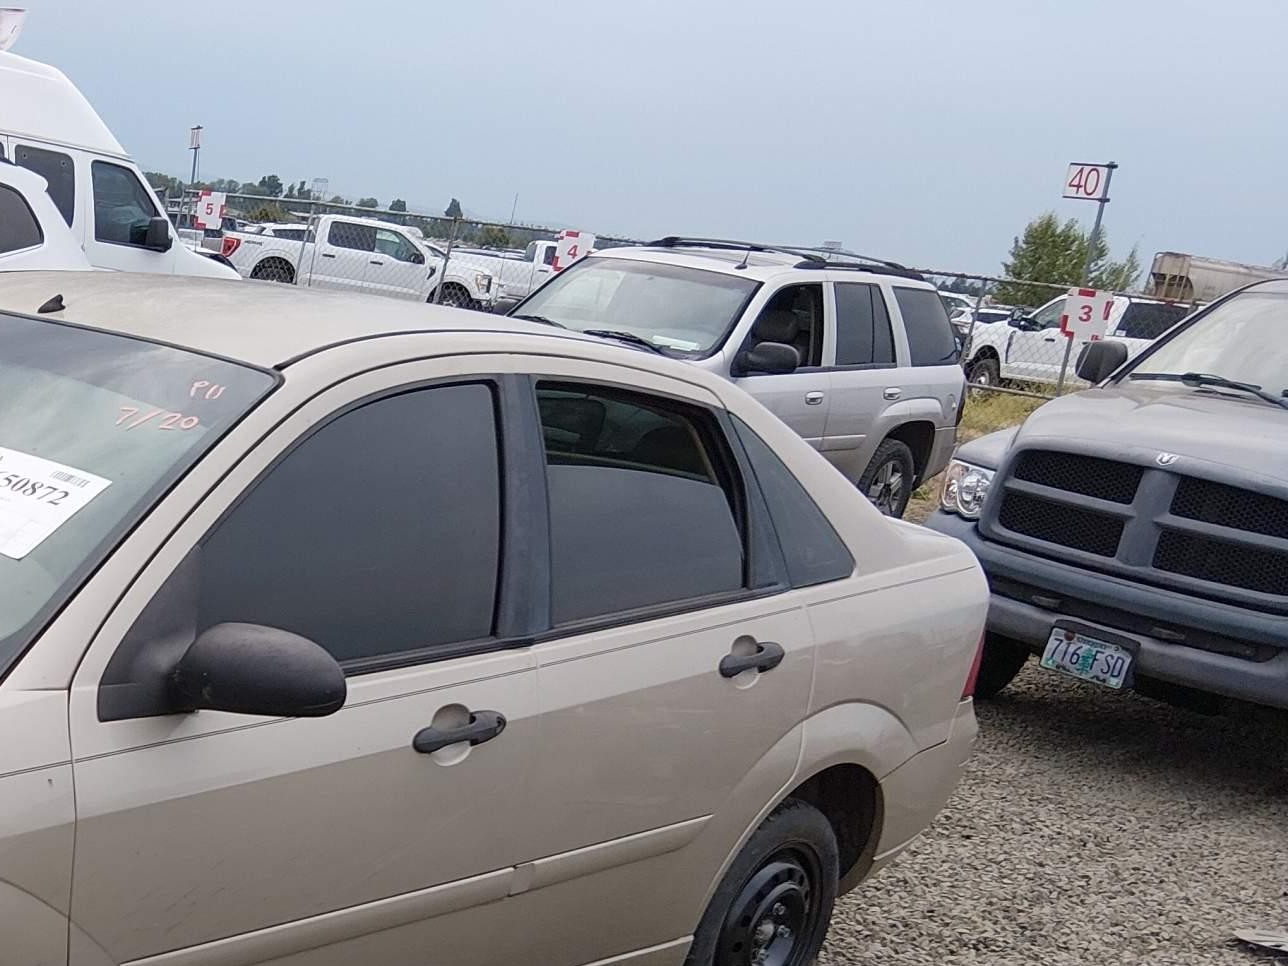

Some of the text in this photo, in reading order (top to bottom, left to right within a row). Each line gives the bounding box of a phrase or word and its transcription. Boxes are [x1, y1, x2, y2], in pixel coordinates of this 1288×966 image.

[1068, 167, 1100, 196] 40
[206, 203, 214, 215] 5
[567, 244, 578, 259] 4
[1078, 305, 1093, 322] 3
[116, 407, 200, 432] 7/20
[1049, 638, 1083, 665] 716
[1090, 651, 1125, 677] FSD
